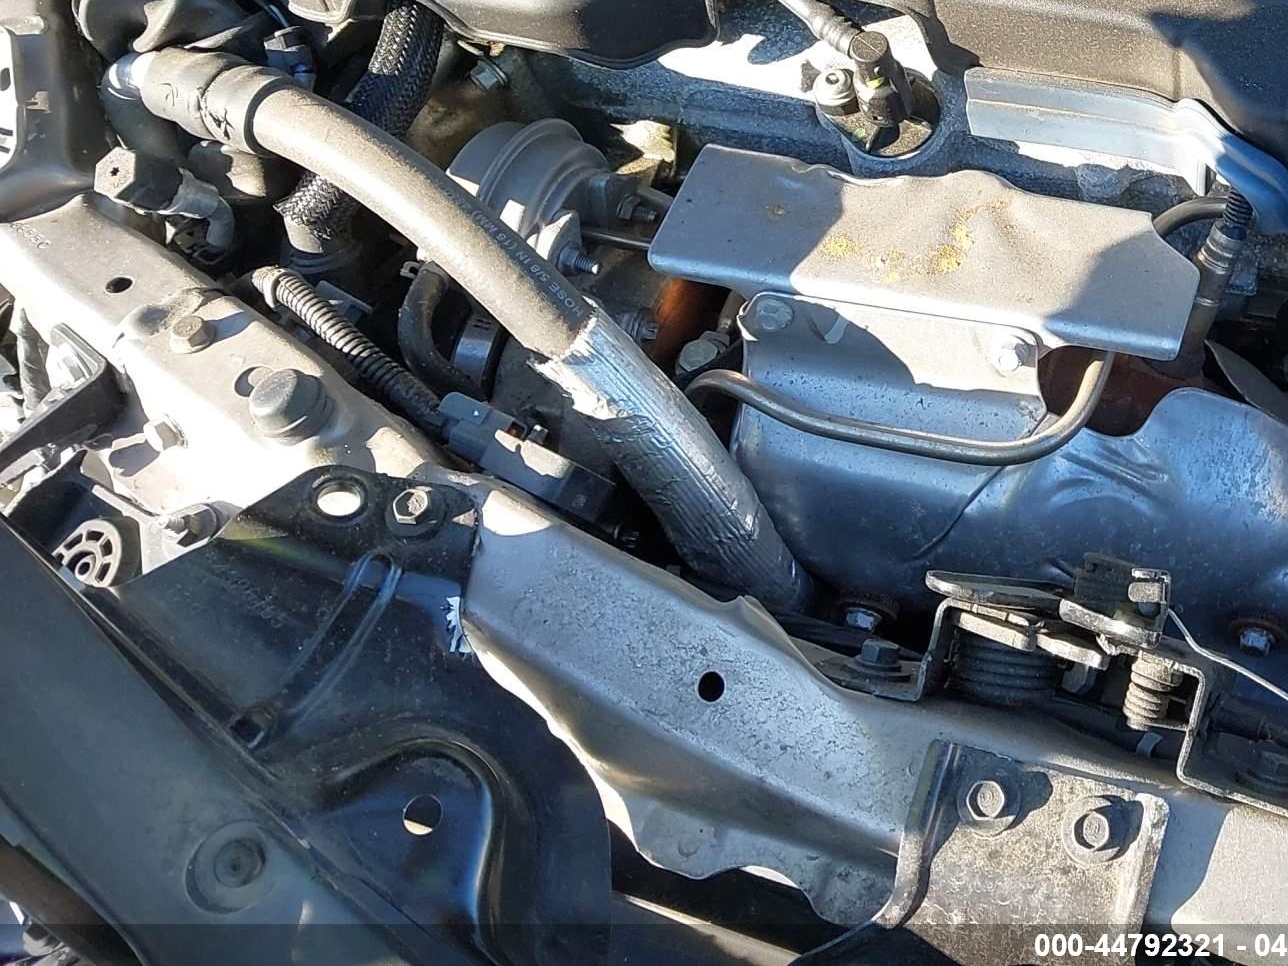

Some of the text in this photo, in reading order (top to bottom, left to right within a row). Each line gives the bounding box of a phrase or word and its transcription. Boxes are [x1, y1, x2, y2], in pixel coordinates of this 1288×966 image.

[471, 209, 498, 234] MM)
[496, 233, 518, 251] (16
[514, 250, 532, 266] IN
[529, 264, 551, 283] 5/8
[547, 280, 584, 318] HOSE
